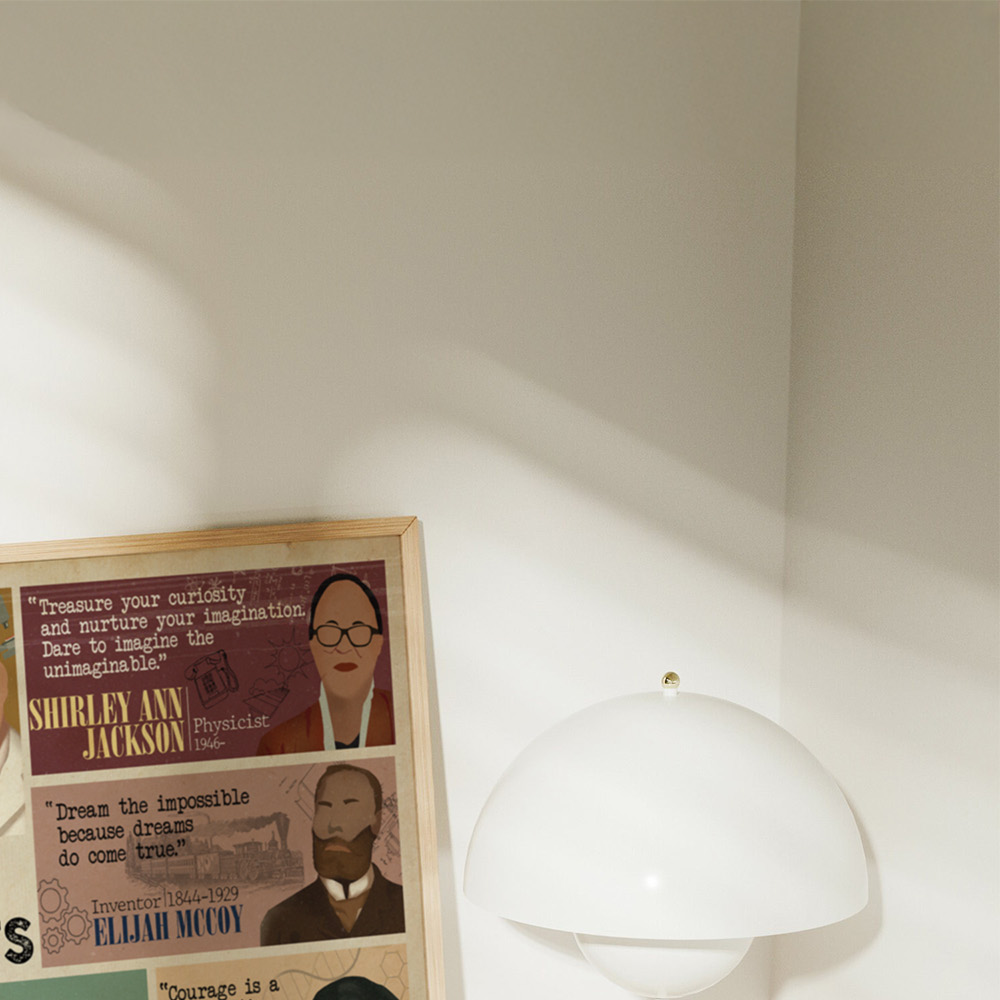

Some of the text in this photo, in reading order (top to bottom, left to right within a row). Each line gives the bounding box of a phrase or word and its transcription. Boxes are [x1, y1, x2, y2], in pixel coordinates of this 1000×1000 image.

[28, 596, 113, 616] “Treasure
[121, 593, 160, 614] your
[168, 584, 246, 606] curiosity
[41, 603, 306, 637] and nurture your imagination.
[42, 629, 214, 658] Dare to imagine the
[43, 653, 167, 679] unimaginable.”
[28, 687, 184, 732] SHIRLEY ANN
[194, 713, 271, 737] Physicist
[82, 720, 185, 760] JACKSON
[194, 736, 225, 752] 1946-
[45, 788, 250, 821] “Dream the impossible
[57, 818, 194, 844] because dreams
[58, 838, 186, 867] do come true.”
[91, 885, 239, 915] Inventor 1844-1929
[94, 904, 243, 947] ELIJAH MCCOY
[245, 978, 261, 995] is
[269, 979, 280, 992] a
